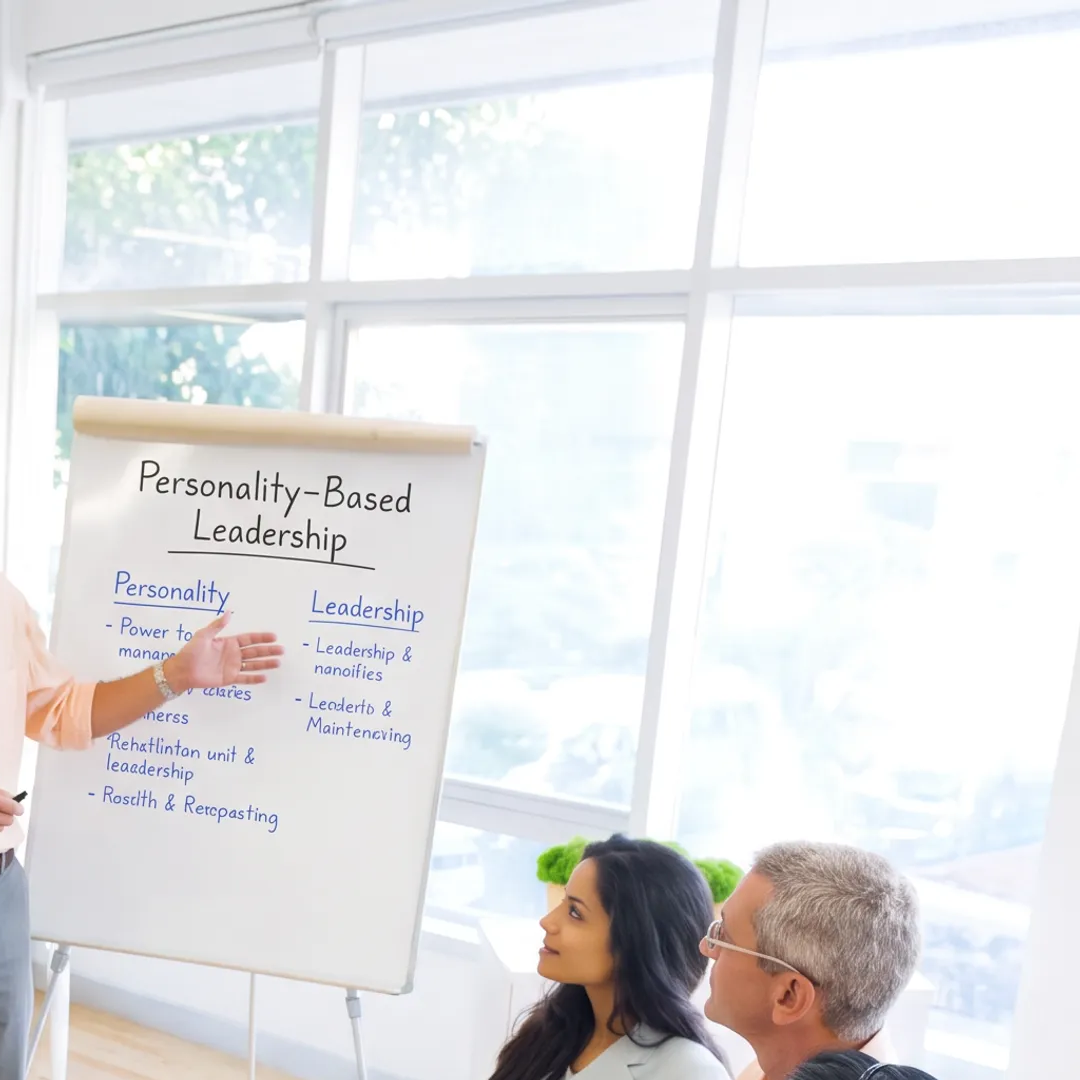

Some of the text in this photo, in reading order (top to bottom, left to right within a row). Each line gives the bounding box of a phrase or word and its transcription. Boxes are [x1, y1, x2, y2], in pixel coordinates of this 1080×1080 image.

[138, 459, 413, 519] Personality-Based
[193, 508, 348, 562] Leadership
[114, 570, 230, 616] Personality
[311, 589, 425, 632] Leadership
[120, 616, 193, 642] Power to
[316, 636, 413, 666] Leadership &
[381, 700, 393, 718] &
[207, 746, 238, 763] unit
[244, 747, 256, 766] &
[164, 793, 177, 813] &
